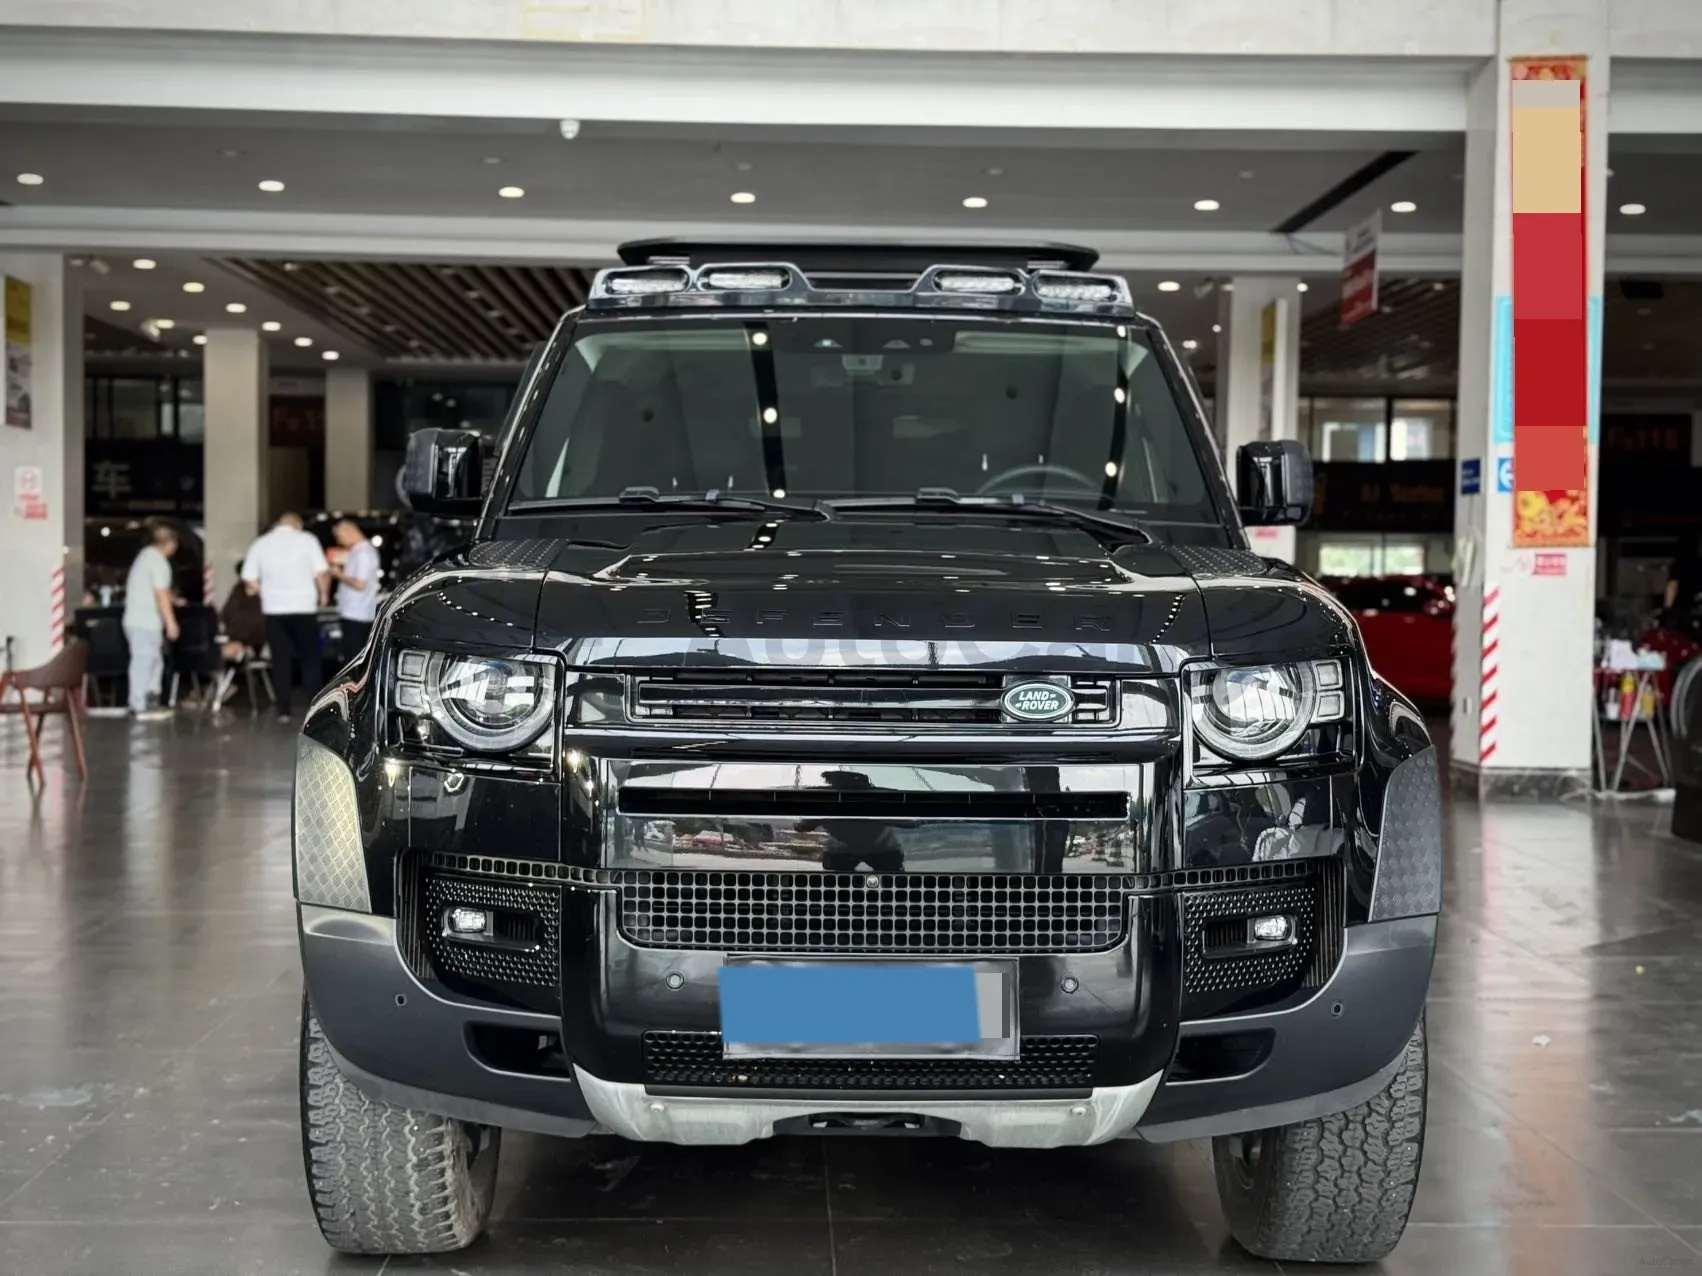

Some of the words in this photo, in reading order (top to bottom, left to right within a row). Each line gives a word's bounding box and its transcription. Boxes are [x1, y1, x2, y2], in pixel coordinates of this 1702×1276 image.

[636, 606, 1111, 632] DEFENDER
[1018, 690, 1050, 701] LAND
[1021, 700, 1060, 711] ROVER
